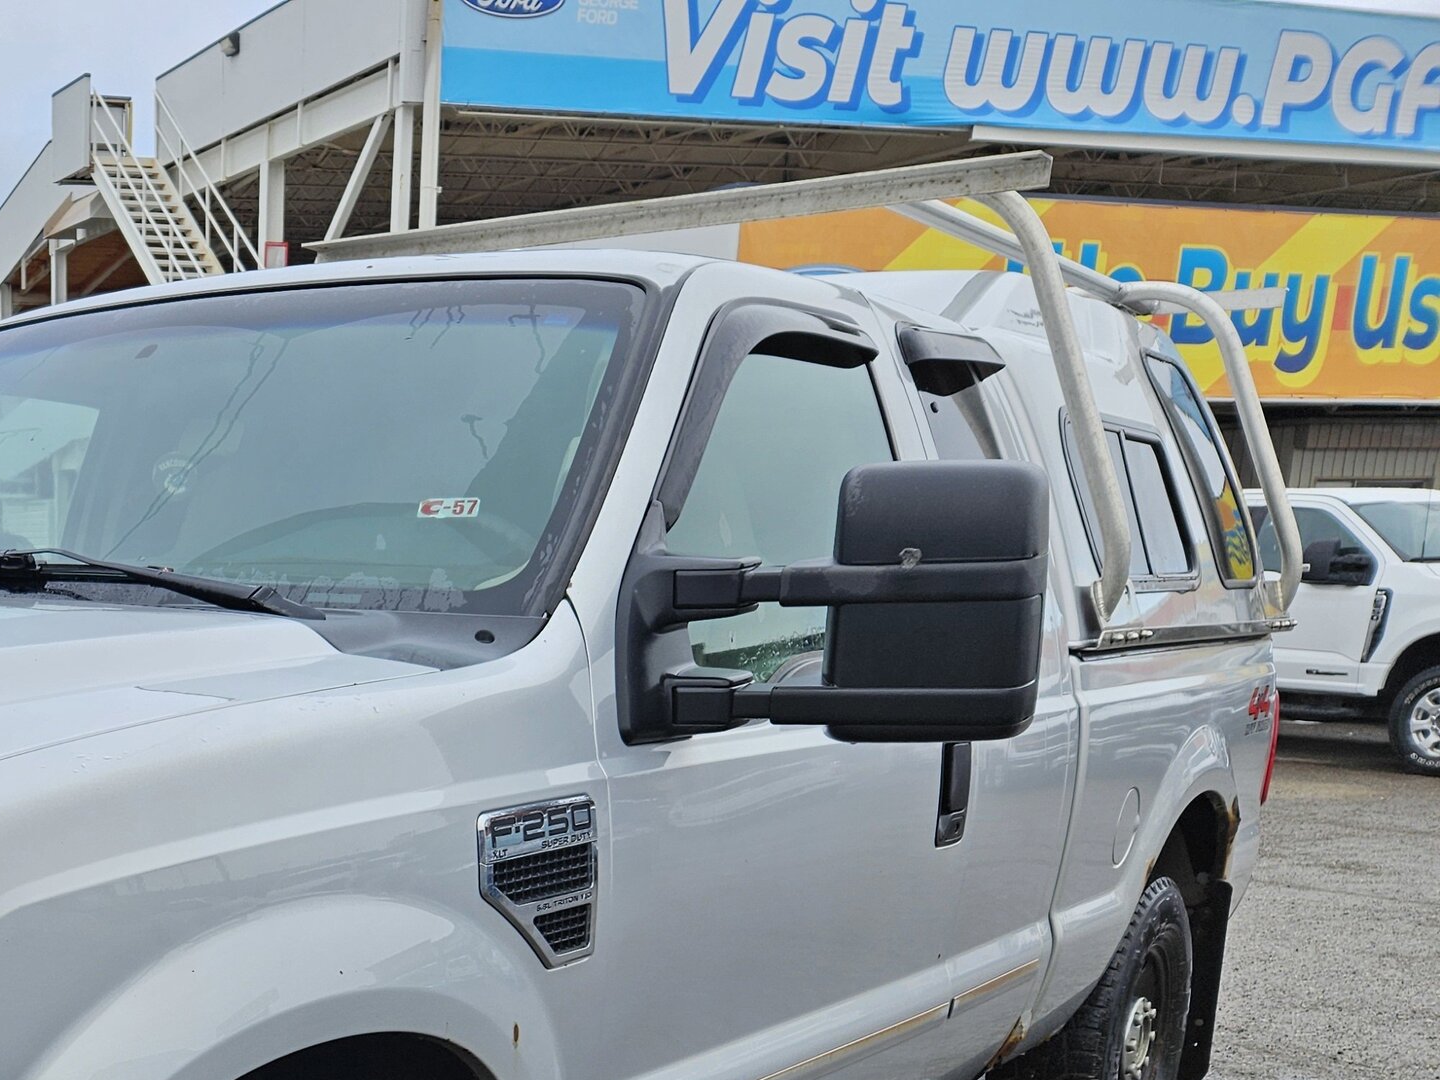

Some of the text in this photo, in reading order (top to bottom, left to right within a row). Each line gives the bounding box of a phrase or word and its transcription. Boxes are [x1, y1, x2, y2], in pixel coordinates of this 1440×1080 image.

[576, 9, 618, 25] FORD
[662, 0, 916, 107] Visit
[1169, 244, 1333, 373] Buy
[420, 499, 478, 516] C-57
[488, 802, 593, 849] F-250
[541, 831, 594, 850] SUPER DUTY
[492, 849, 509, 860] XLT
